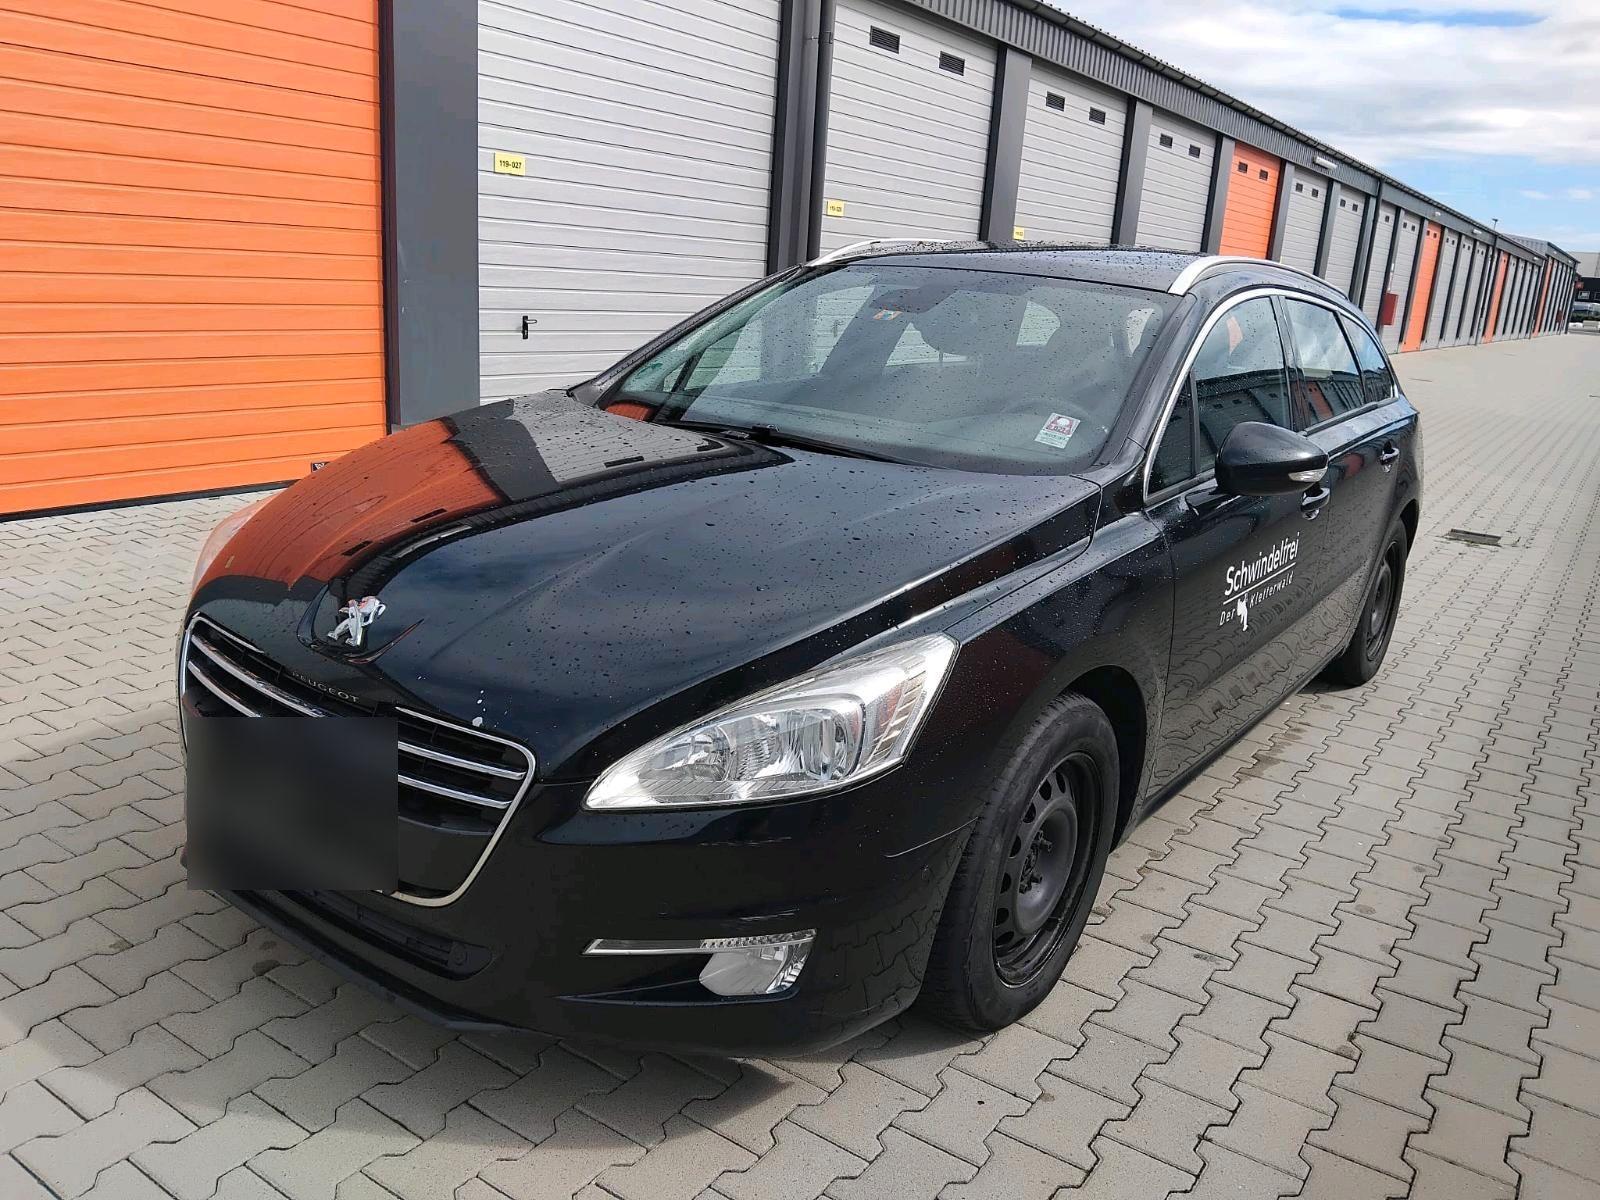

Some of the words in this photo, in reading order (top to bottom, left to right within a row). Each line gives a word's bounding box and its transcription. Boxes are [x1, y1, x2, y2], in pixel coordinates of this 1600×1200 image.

[499, 159, 522, 169] 119-027
[1224, 531, 1300, 596] Schwindelfrei
[1219, 608, 1236, 626] Der
[1249, 570, 1294, 609] Kletterwald
[292, 671, 359, 702] PEUGEOT
